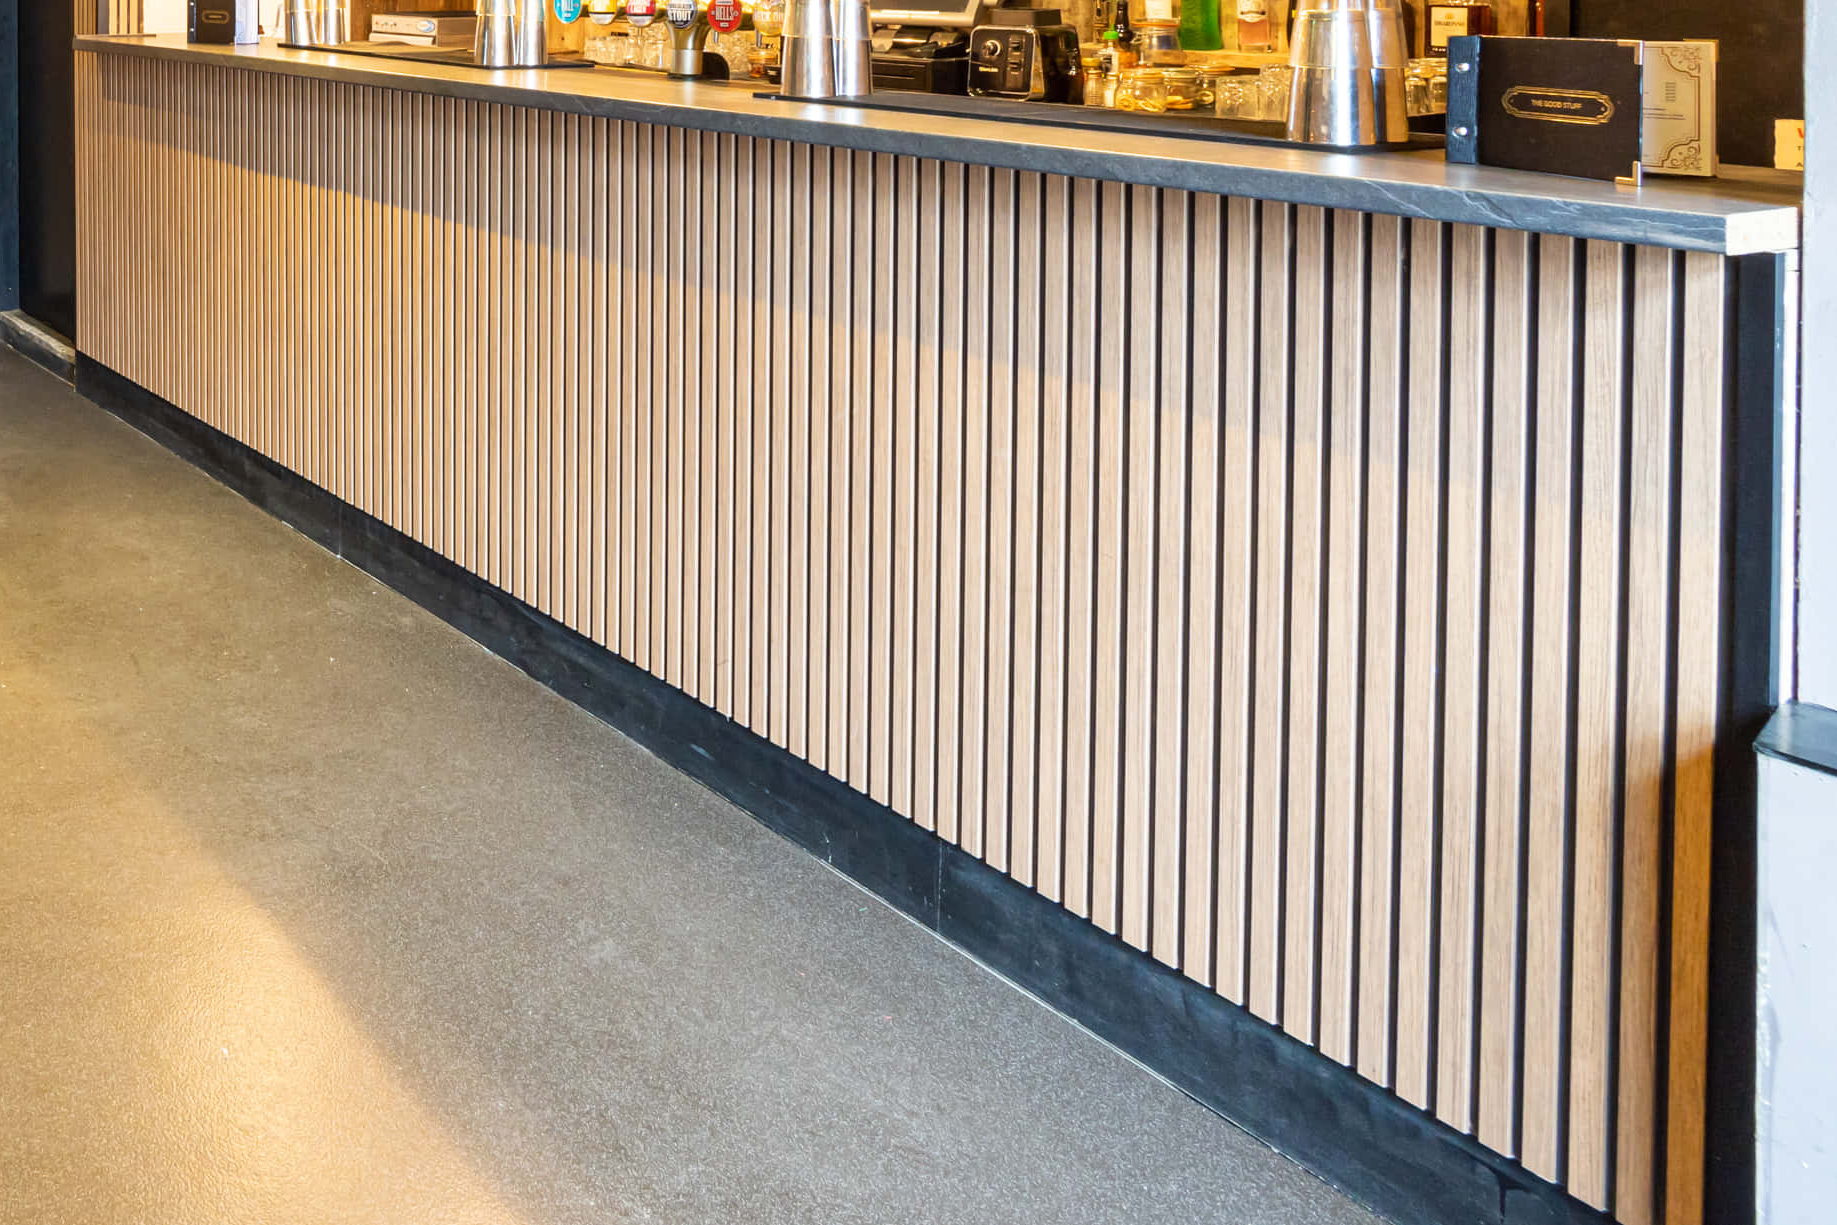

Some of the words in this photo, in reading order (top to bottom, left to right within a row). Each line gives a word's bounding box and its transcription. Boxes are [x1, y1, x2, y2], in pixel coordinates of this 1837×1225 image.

[667, 9, 692, 21] STOUT
[715, 6, 734, 21] HELLS
[1531, 99, 1543, 107] THE
[1544, 100, 1562, 109] GOOD
[1563, 102, 1582, 110] STUFF
